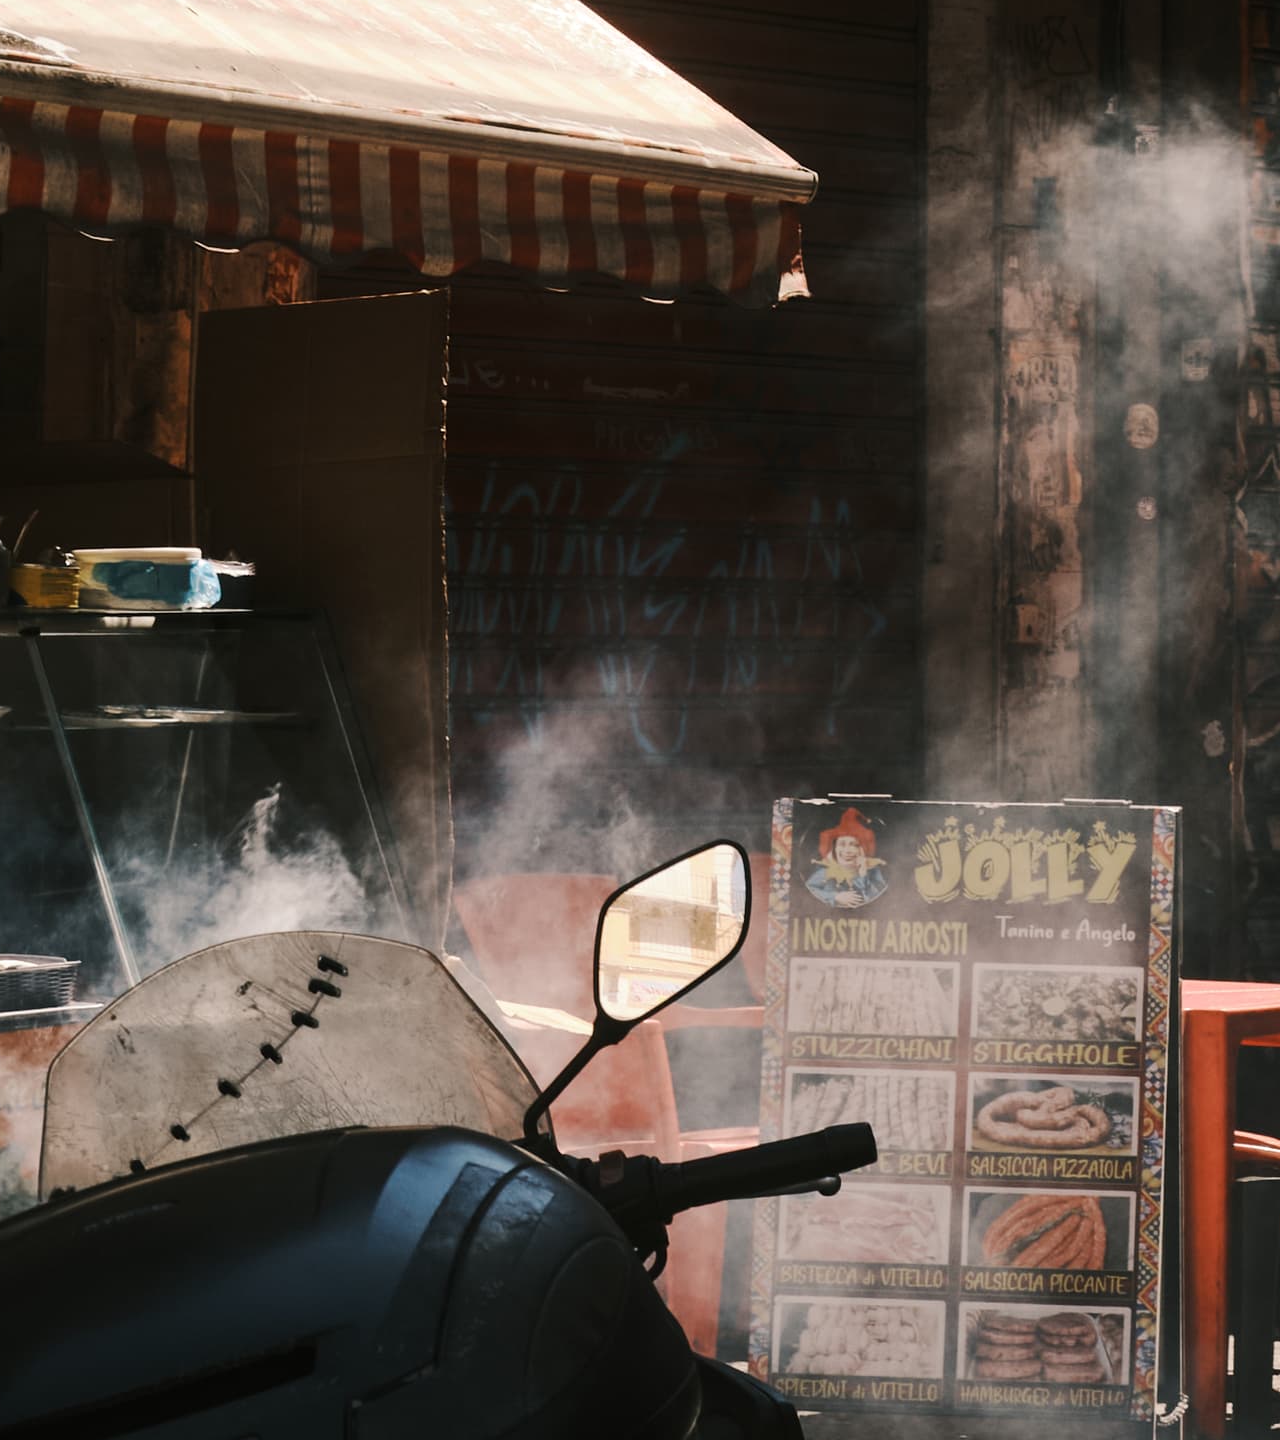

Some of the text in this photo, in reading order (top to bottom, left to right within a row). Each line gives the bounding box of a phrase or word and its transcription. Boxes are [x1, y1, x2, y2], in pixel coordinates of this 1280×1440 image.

[914, 816, 1138, 906] JOLLY
[792, 917, 969, 957] I NOSTRI ARROSTI
[995, 915, 1137, 948] Tanino e Angelo
[791, 1034, 955, 1063] STUZZICHINI
[973, 1040, 1139, 1067] STIGGHIOLE
[879, 1153, 892, 1174] E
[898, 1152, 948, 1176] BEVI
[969, 1154, 1133, 1181] SALSICCIA PIZZAIOLA
[780, 1264, 944, 1289] BISTECCA di VITELLO
[964, 1269, 1128, 1296] SALSICCIA PICCANTE
[775, 1377, 939, 1403] SPIEDINI di VITELLO
[959, 1384, 1127, 1409] HAMBURGER di VITELLO
